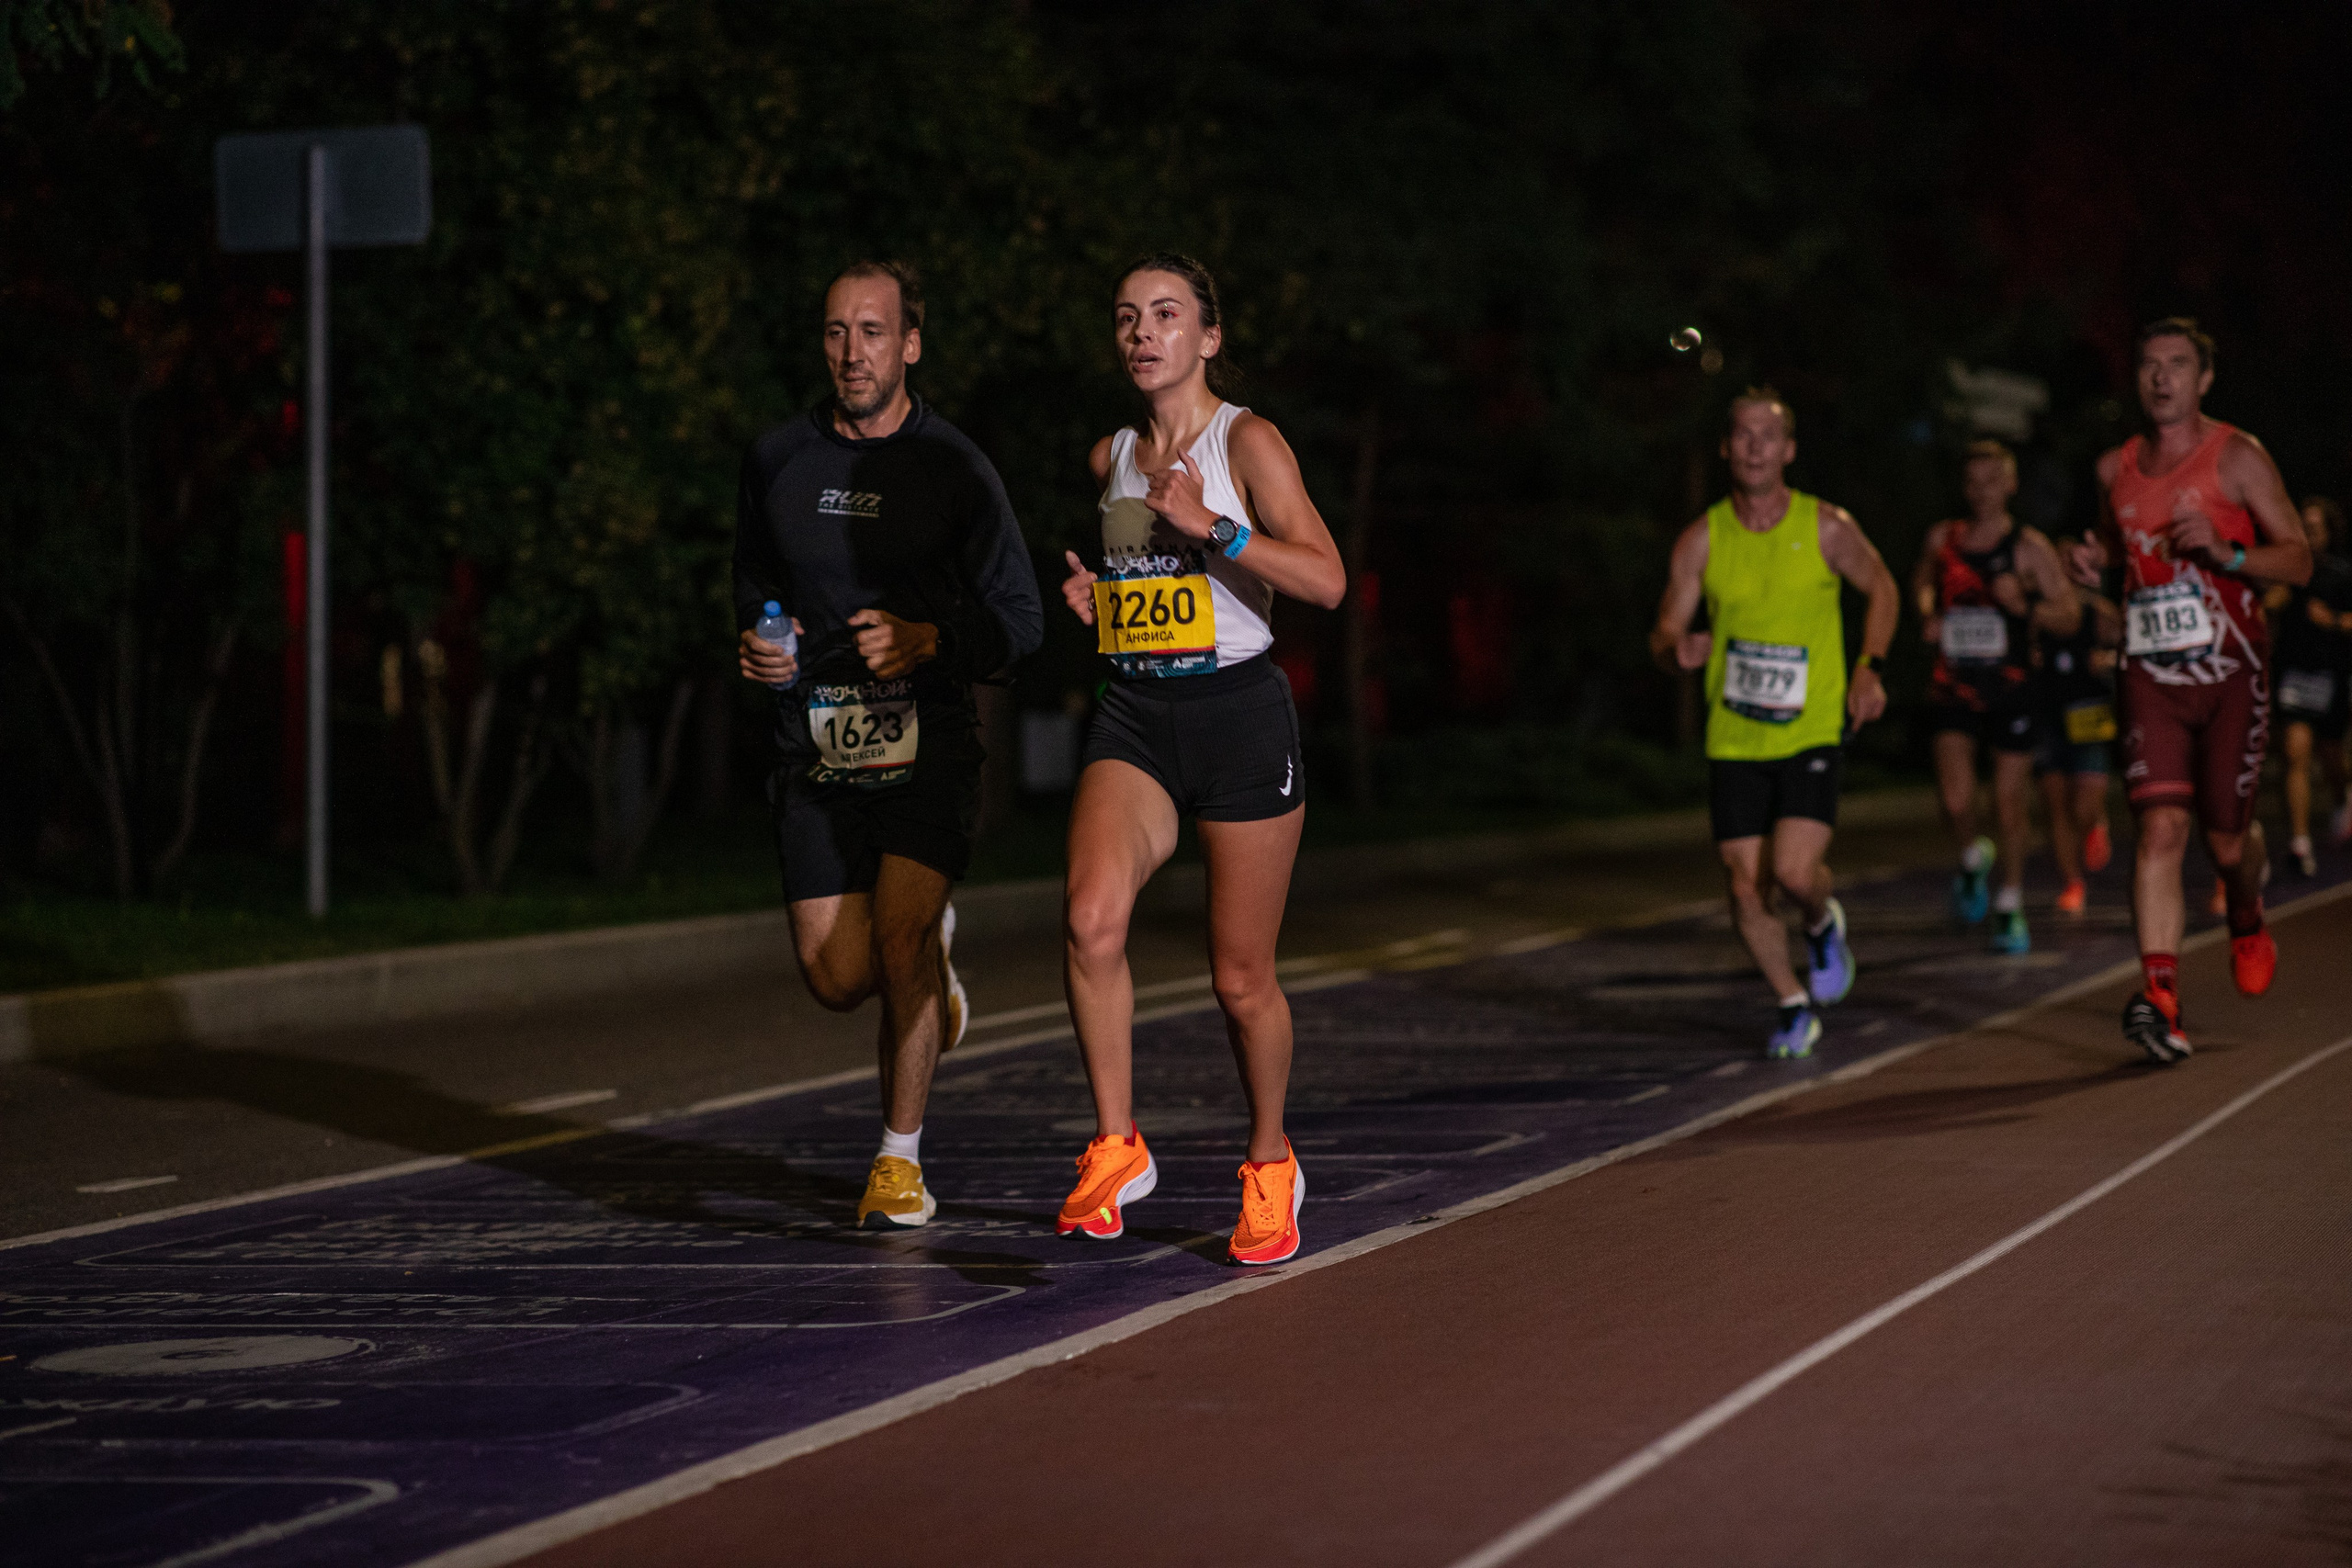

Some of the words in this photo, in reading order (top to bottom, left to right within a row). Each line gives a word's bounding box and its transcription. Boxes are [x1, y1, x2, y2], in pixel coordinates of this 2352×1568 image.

[1109, 588, 1195, 629] 2260
[1125, 631, 1175, 644] АНФИСА
[824, 711, 903, 750] 1623
